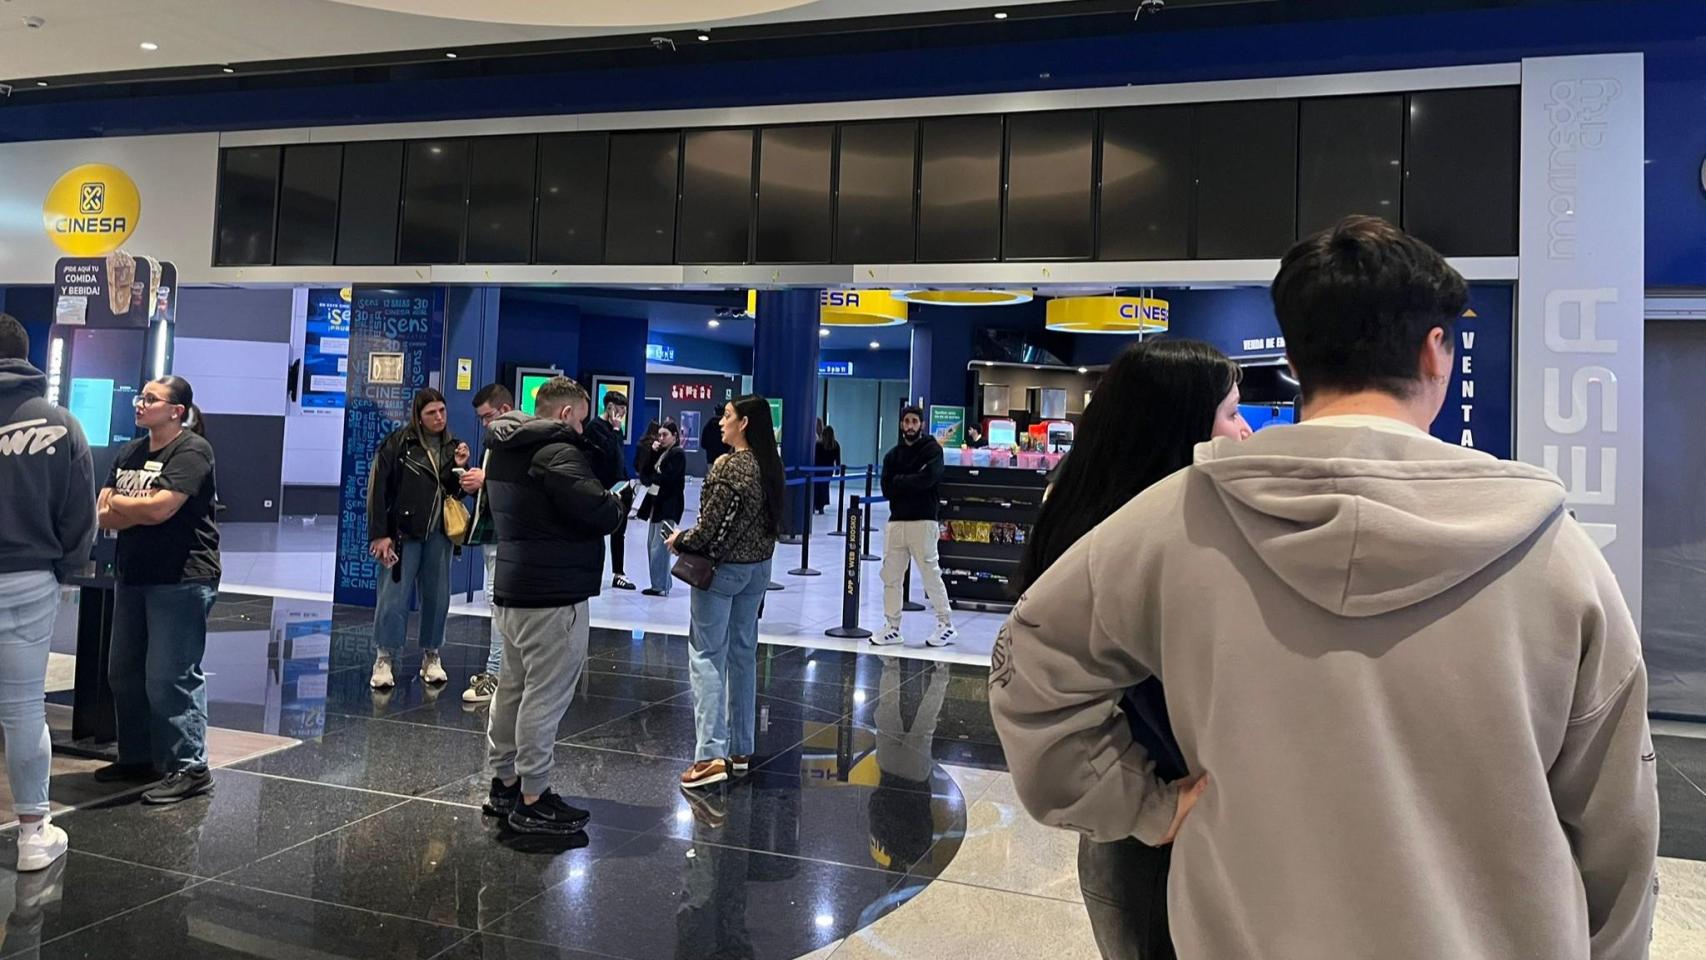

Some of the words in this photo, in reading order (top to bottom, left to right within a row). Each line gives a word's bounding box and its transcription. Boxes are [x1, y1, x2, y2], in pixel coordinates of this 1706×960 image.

[55, 216, 126, 233] CINESA
[91, 265, 99, 273] TU
[65, 274, 97, 283] COMIDA
[61, 286, 68, 296] Y
[68, 286, 100, 296] BEBIDA!
[383, 316, 428, 339] iSens
